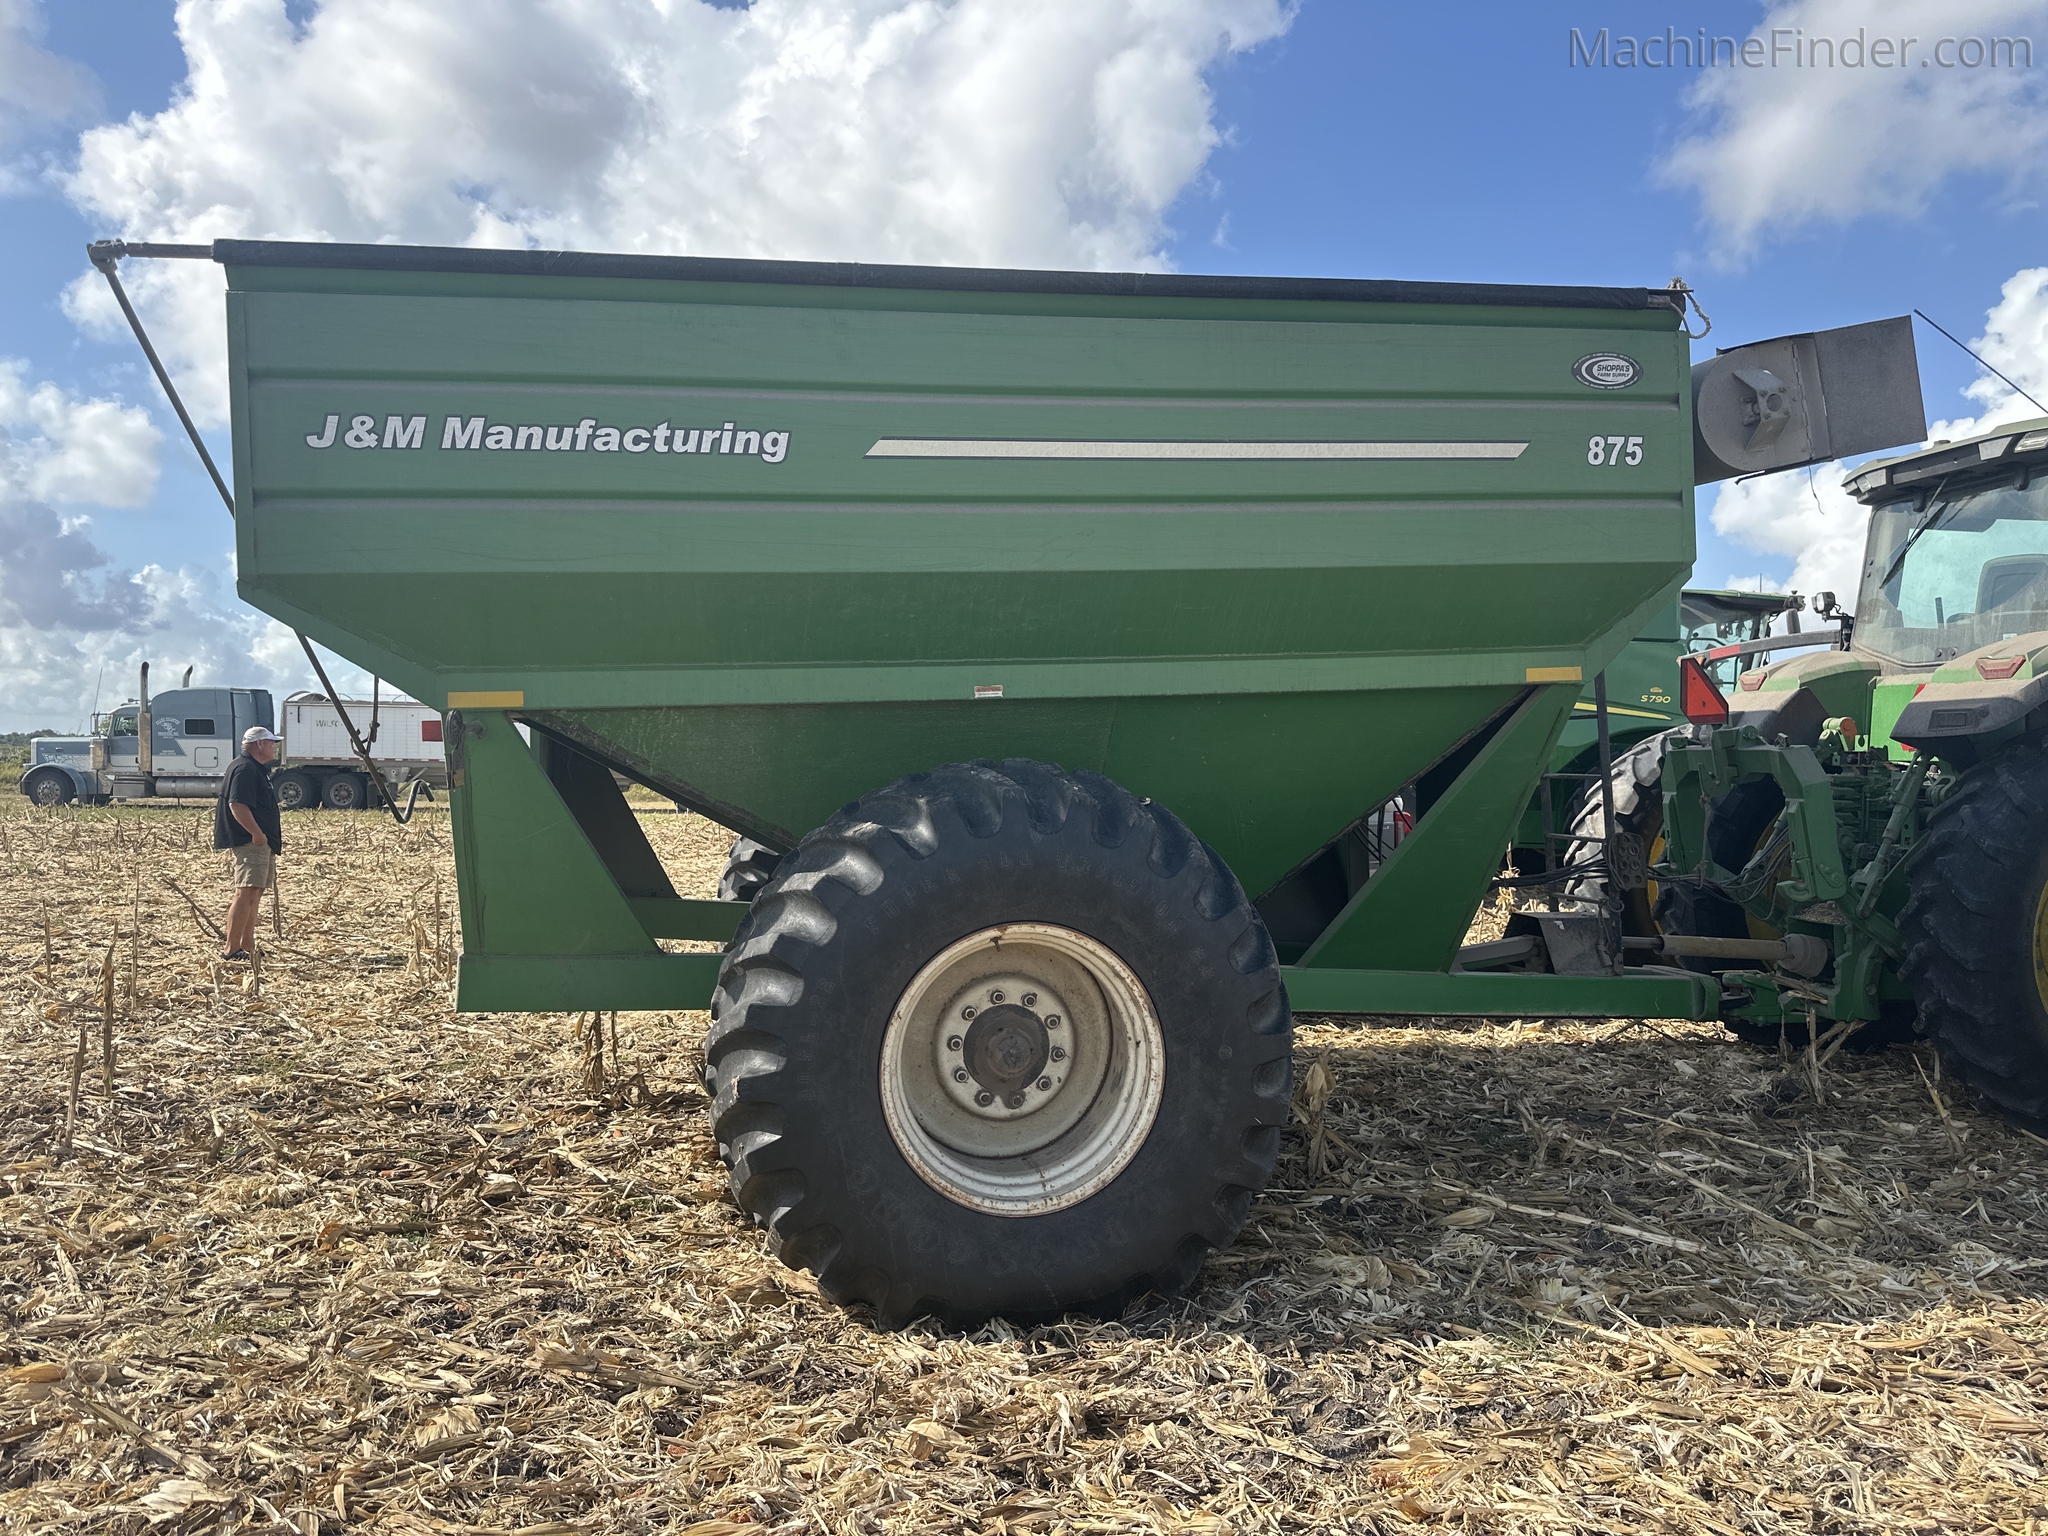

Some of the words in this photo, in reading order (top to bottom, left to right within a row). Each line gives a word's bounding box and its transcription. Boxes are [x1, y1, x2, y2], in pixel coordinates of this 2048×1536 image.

[1597, 364, 1630, 372] SHOPPA'S
[305, 413, 428, 450] J&M
[440, 415, 792, 464] Manufacturing
[1587, 435, 1644, 466] 875
[1640, 694, 1671, 703] S790
[863, 864, 962, 936] SUPER
[978, 847, 1035, 874] ALL
[1054, 849, 1189, 935] TRACTION
